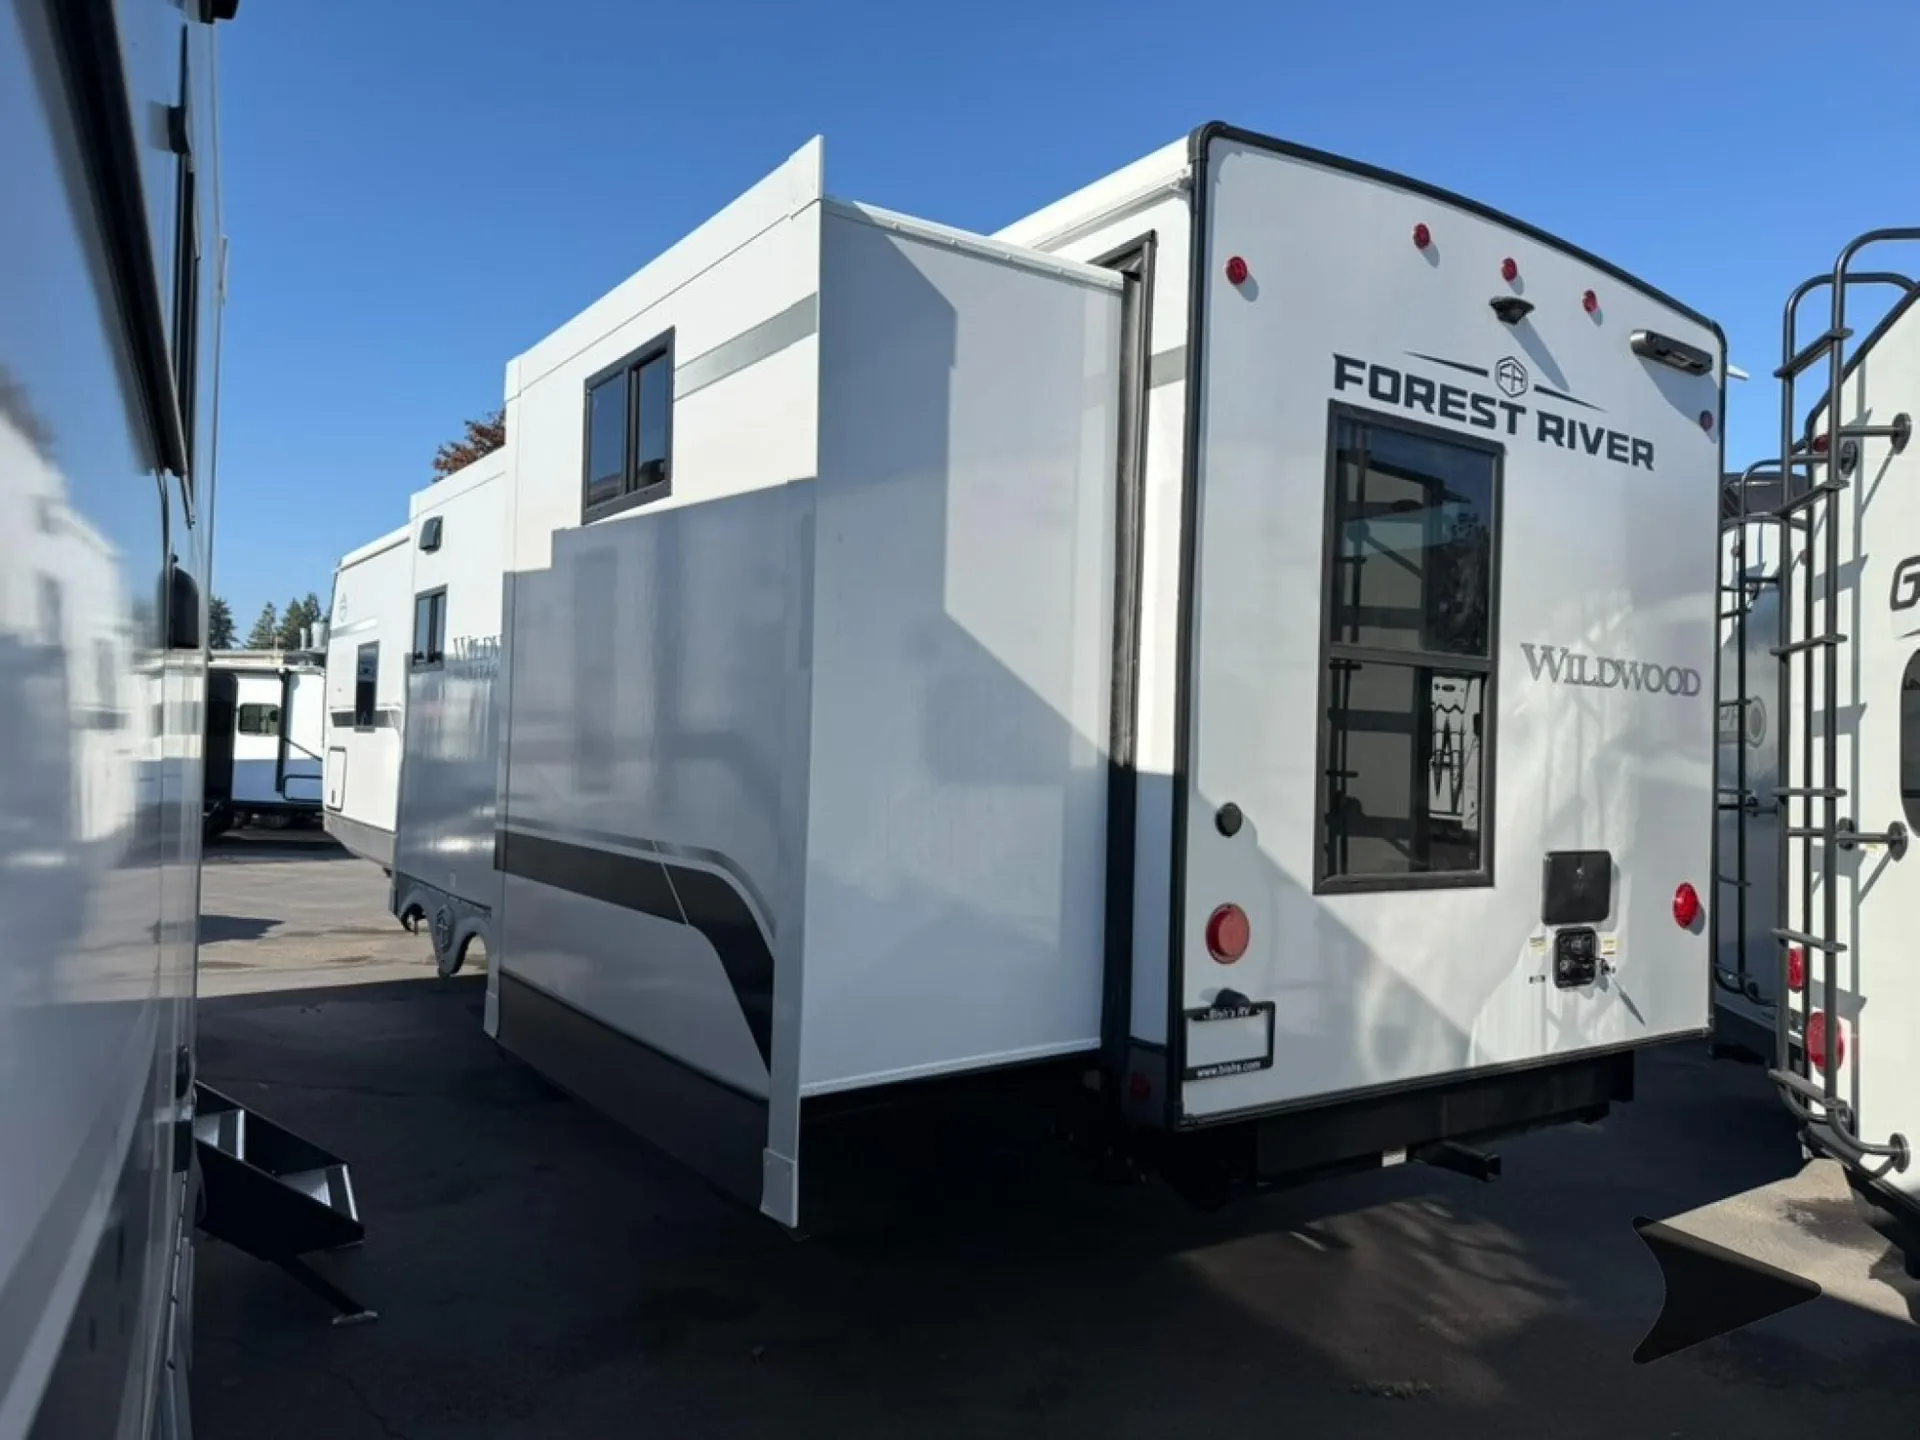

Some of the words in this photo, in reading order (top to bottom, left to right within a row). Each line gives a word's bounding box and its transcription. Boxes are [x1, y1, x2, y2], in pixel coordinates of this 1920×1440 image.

[1333, 353, 1527, 434] FOREST
[1537, 411, 1655, 471] RIVER
[1520, 643, 1702, 697] WILDWOOD
